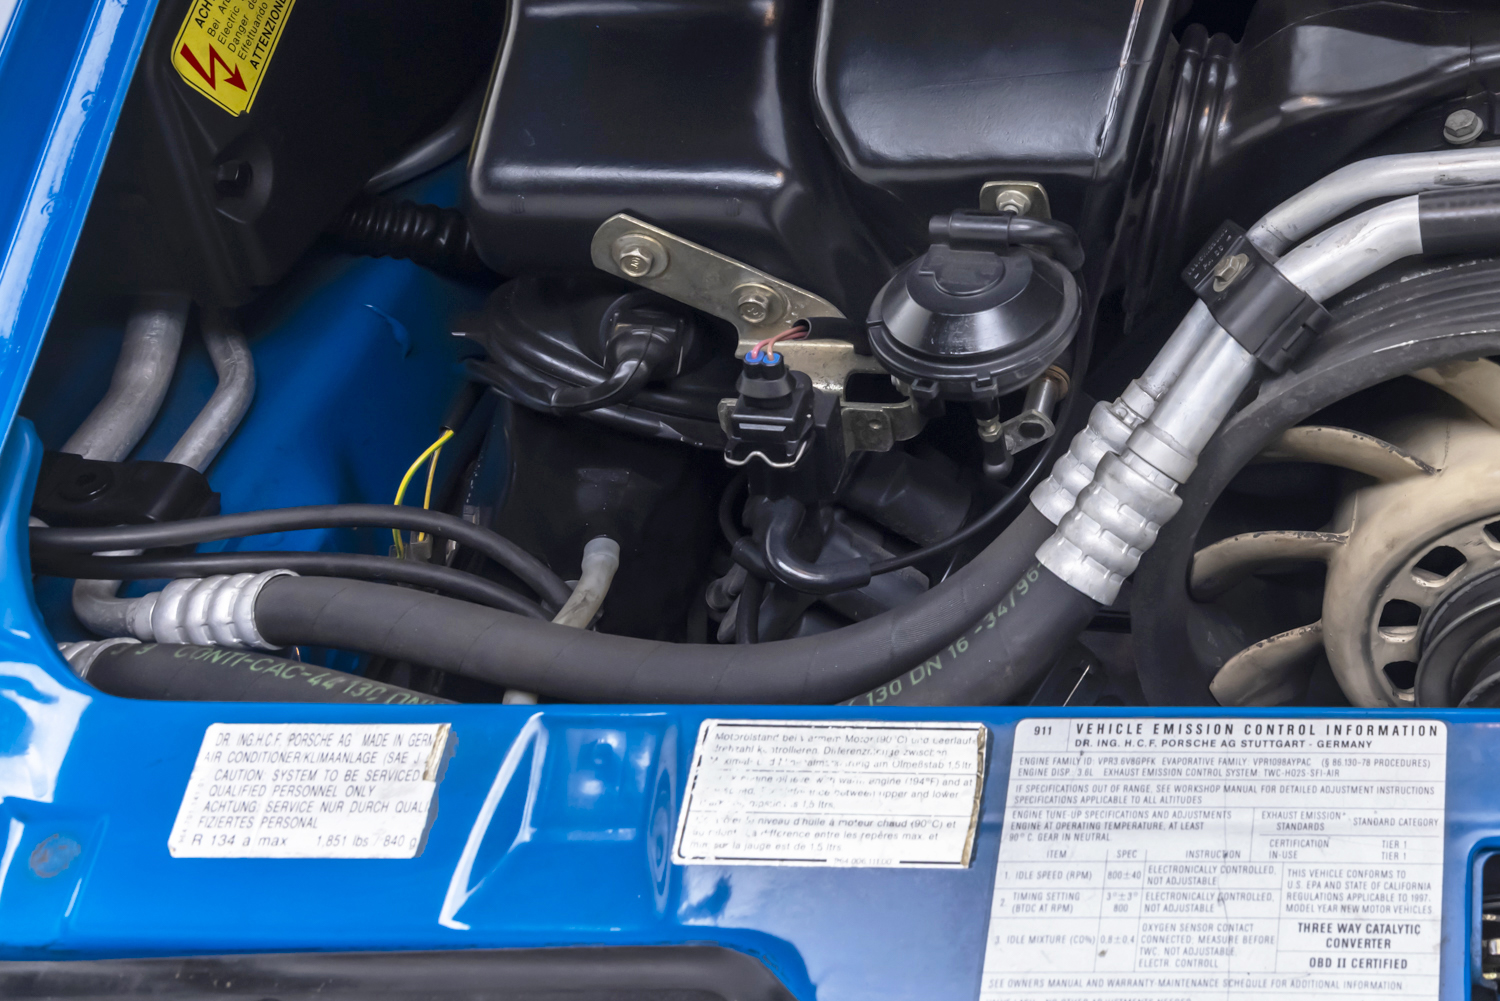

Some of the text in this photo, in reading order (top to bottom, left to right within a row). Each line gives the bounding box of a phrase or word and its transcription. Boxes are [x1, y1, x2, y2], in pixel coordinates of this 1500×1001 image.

[217, 5, 240, 45] Electric
[865, 680, 902, 706] 130
[909, 655, 943, 685] DN
[947, 637, 969, 658] 16
[1034, 723, 1437, 736] 911 VEHICLE EMISSION CONTROL INFORMATION
[288, 733, 333, 747] PORSCHE
[338, 733, 351, 747] AG
[362, 733, 390, 747] MADE
[393, 733, 404, 746] IN
[1074, 739, 1092, 747] DR.
[1097, 739, 1120, 747] ING.
[1161, 739, 1217, 748] PORSCHE
[1220, 739, 1236, 748] AG
[1240, 740, 1306, 748] STUTTGART
[1317, 740, 1372, 748] GERMANY
[204, 752, 222, 763] AIR
[1019, 757, 1050, 766] ENGINE
[1052, 757, 1081, 766] FAMILY
[1161, 757, 1215, 766] EVAPORATIVE
[1374, 758, 1431, 768] PROCEDURES)
[272, 769, 317, 781] SYSTEM
[323, 769, 339, 781] TO
[344, 769, 358, 781] BE
[365, 769, 421, 782] SERVICED
[1017, 768, 1048, 777] ENGINE
[1077, 768, 1093, 777] 3.6L
[1103, 768, 1140, 777] EXHAUST
[1141, 768, 1182, 777] EMISSION
[1185, 768, 1223, 777] CONTROL
[942, 778, 960, 787] and
[963, 779, 973, 787] at
[208, 784, 376, 798] QUALIFIED PERSONNEL ONLY
[265, 800, 314, 813] SERVICE
[320, 800, 344, 813] NUR
[349, 800, 389, 813] DURCH
[198, 816, 318, 829] FIZIERTES PERSONAL
[877, 819, 907, 828] chaud
[946, 821, 956, 829] et
[1353, 817, 1439, 827] STANDARD CATEGORY
[191, 833, 203, 846] R
[211, 834, 236, 847] 134
[257, 837, 289, 847] max
[352, 834, 369, 847] lbs
[382, 834, 405, 847] 840
[1297, 922, 1421, 935] THREE WAY CATALYTIC
[1326, 937, 1391, 949] CONVERTER
[1309, 957, 1408, 969] OBD II CERTIFIED
